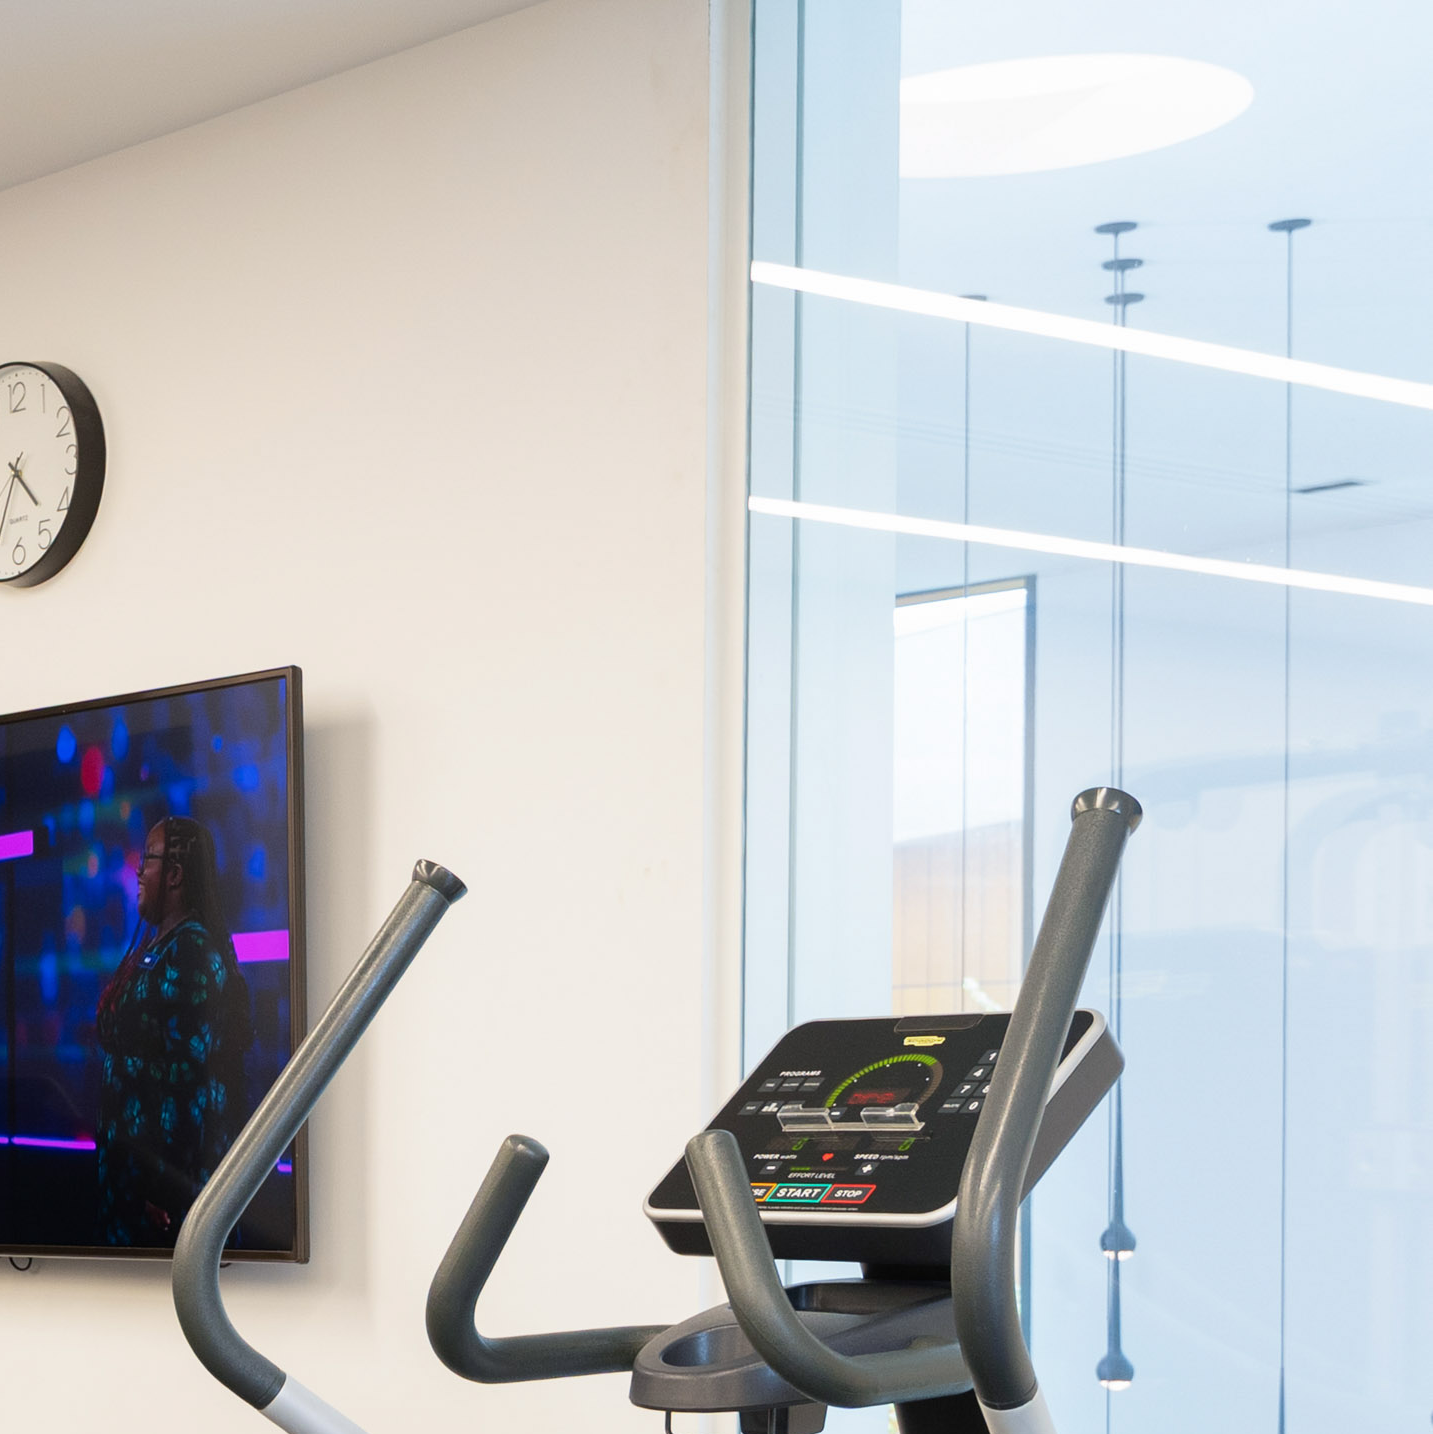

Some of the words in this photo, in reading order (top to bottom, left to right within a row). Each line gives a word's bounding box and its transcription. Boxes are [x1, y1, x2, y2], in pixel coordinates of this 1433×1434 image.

[8, 381, 27, 414] 12
[56, 405, 71, 438] 2
[65, 444, 77, 475] 3
[38, 519, 52, 550] 5
[12, 536, 26, 565] 6
[973, 1069, 984, 1078] 4
[961, 1085, 971, 1094] 7
[969, 1101, 979, 1111] 0
[776, 1188, 821, 1198] START
[834, 1189, 864, 1198] STOP
